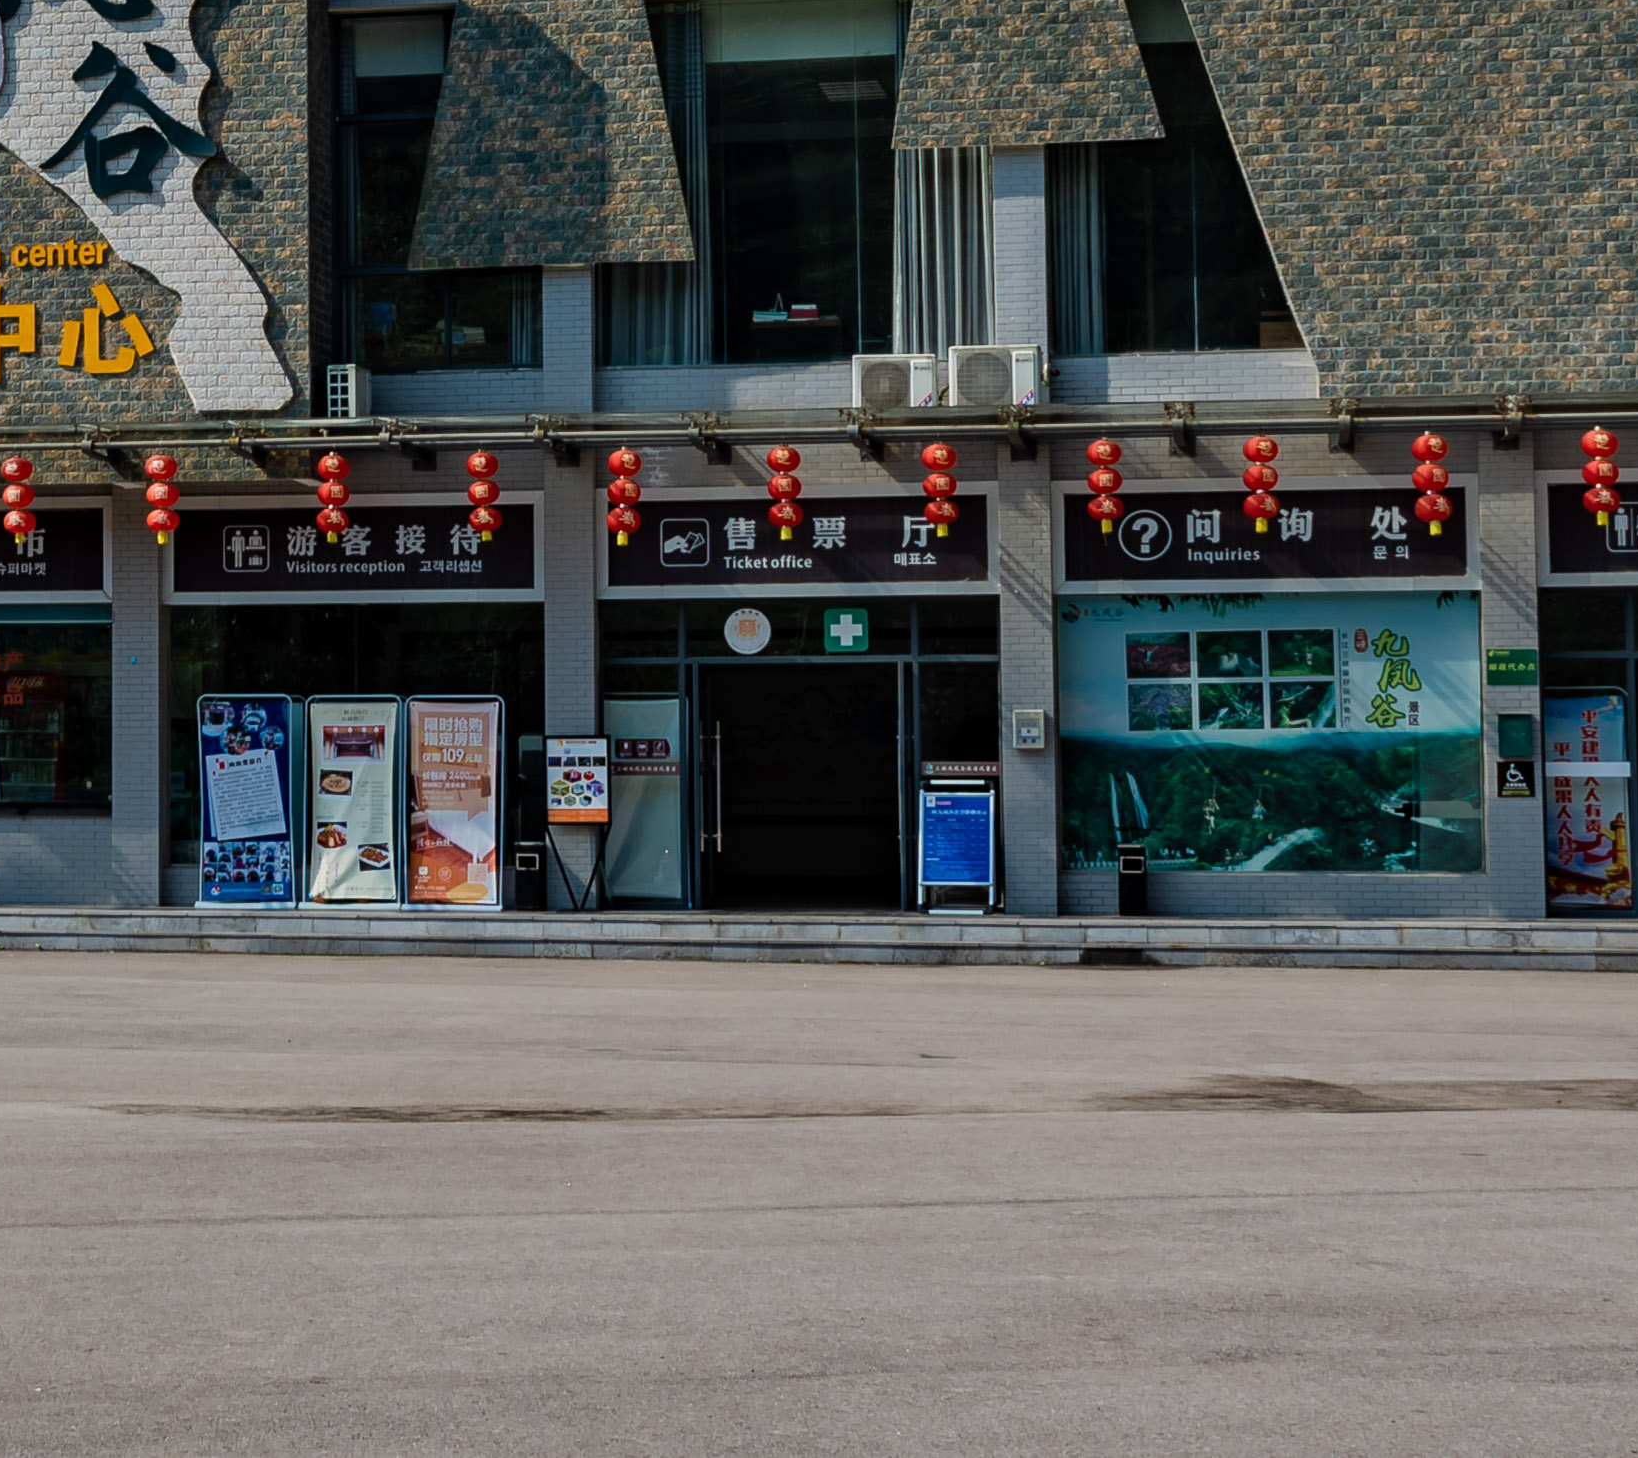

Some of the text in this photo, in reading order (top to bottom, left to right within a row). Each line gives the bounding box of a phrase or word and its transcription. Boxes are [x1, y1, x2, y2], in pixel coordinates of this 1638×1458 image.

[12, 240, 109, 267] center
[725, 516, 936, 551] 售票厅
[1187, 506, 1409, 544] 问询处
[287, 525, 483, 557] 游客接待
[286, 560, 405, 576] Visitors reception
[724, 554, 813, 570] Ticket office
[1188, 548, 1261, 564] Inquiries
[1365, 628, 1422, 728] 九凤谷
[1407, 701, 1421, 726] 景区
[1553, 741, 1575, 866] 平成果人人共享
